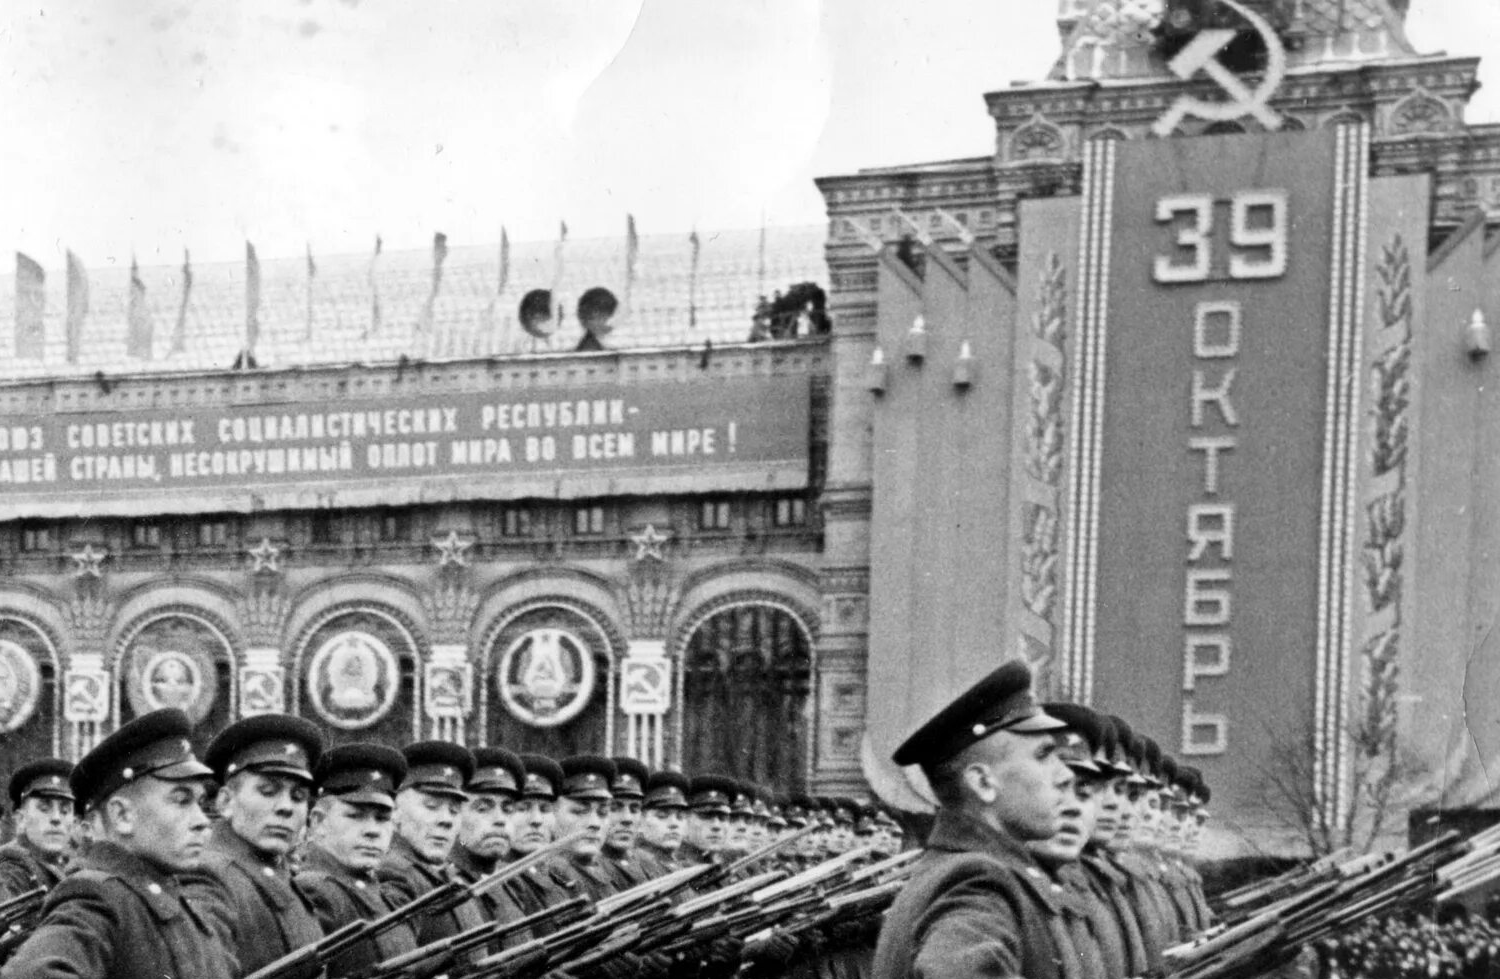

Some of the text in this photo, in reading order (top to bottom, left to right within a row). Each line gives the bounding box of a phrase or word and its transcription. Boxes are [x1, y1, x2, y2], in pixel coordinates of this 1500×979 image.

[1153, 190, 1288, 283] 39
[67, 419, 196, 449] СОВЕТСКИХ
[218, 407, 458, 443] СОЦИАЛИСТИЧЕСКИХ
[481, 399, 640, 431] РЕСПУБЛИК-
[70, 454, 162, 483] СТРАНЫ,
[170, 440, 352, 478] НЕСОКРУШИМЫЙ
[367, 442, 438, 469] ОПЛОТ
[451, 438, 512, 465] МИРА
[525, 436, 556, 462] ВО
[572, 432, 635, 460] ВСЕМ
[1180, 301, 1242, 756] ОКТЯБРЬ
